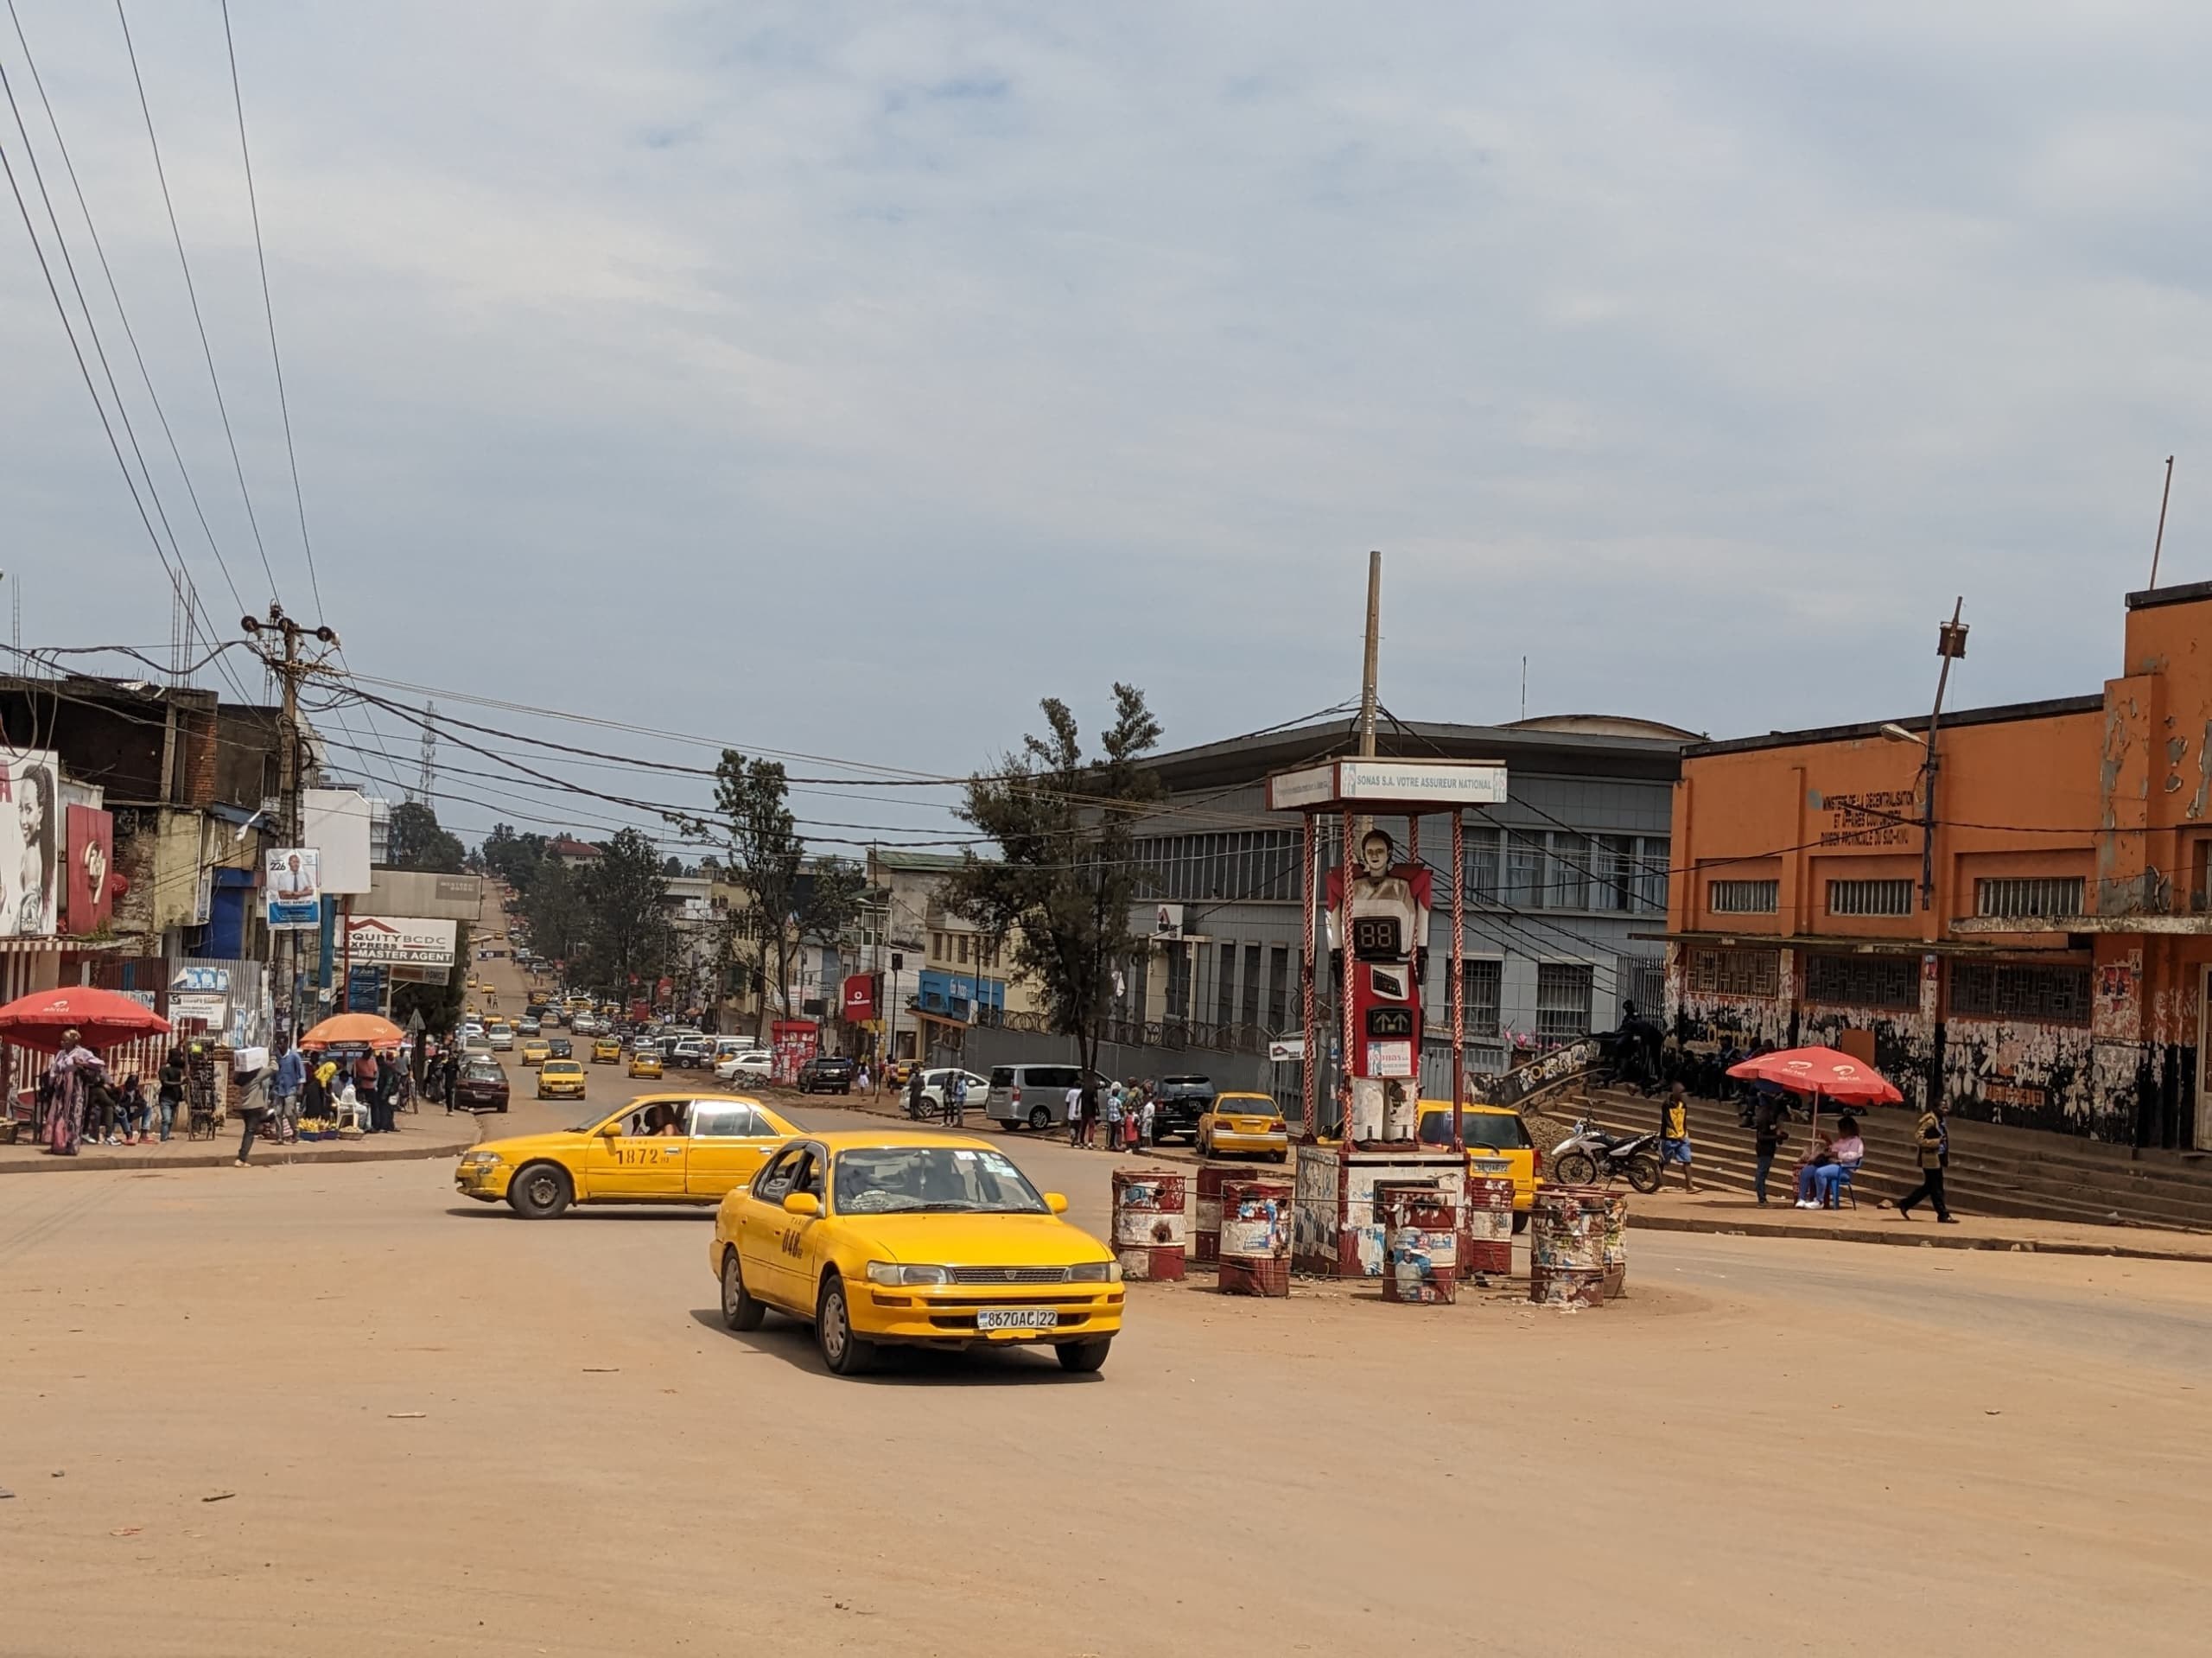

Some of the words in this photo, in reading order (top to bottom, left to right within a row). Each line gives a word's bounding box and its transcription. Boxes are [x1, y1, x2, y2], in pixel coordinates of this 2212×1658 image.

[1357, 774, 1380, 785] SONAS
[1396, 777, 1420, 788] VOTRE
[1421, 777, 1457, 789] ASSUREUR
[1458, 778, 1492, 790] NATIONAL
[349, 933, 401, 943] QUITY
[403, 936, 446, 944] BCDC
[350, 941, 397, 950] XPRESS
[358, 950, 408, 960] MASTER
[410, 951, 452, 962] AGENT
[616, 1148, 658, 1165] 1872
[1039, 1312, 1056, 1326] 22
